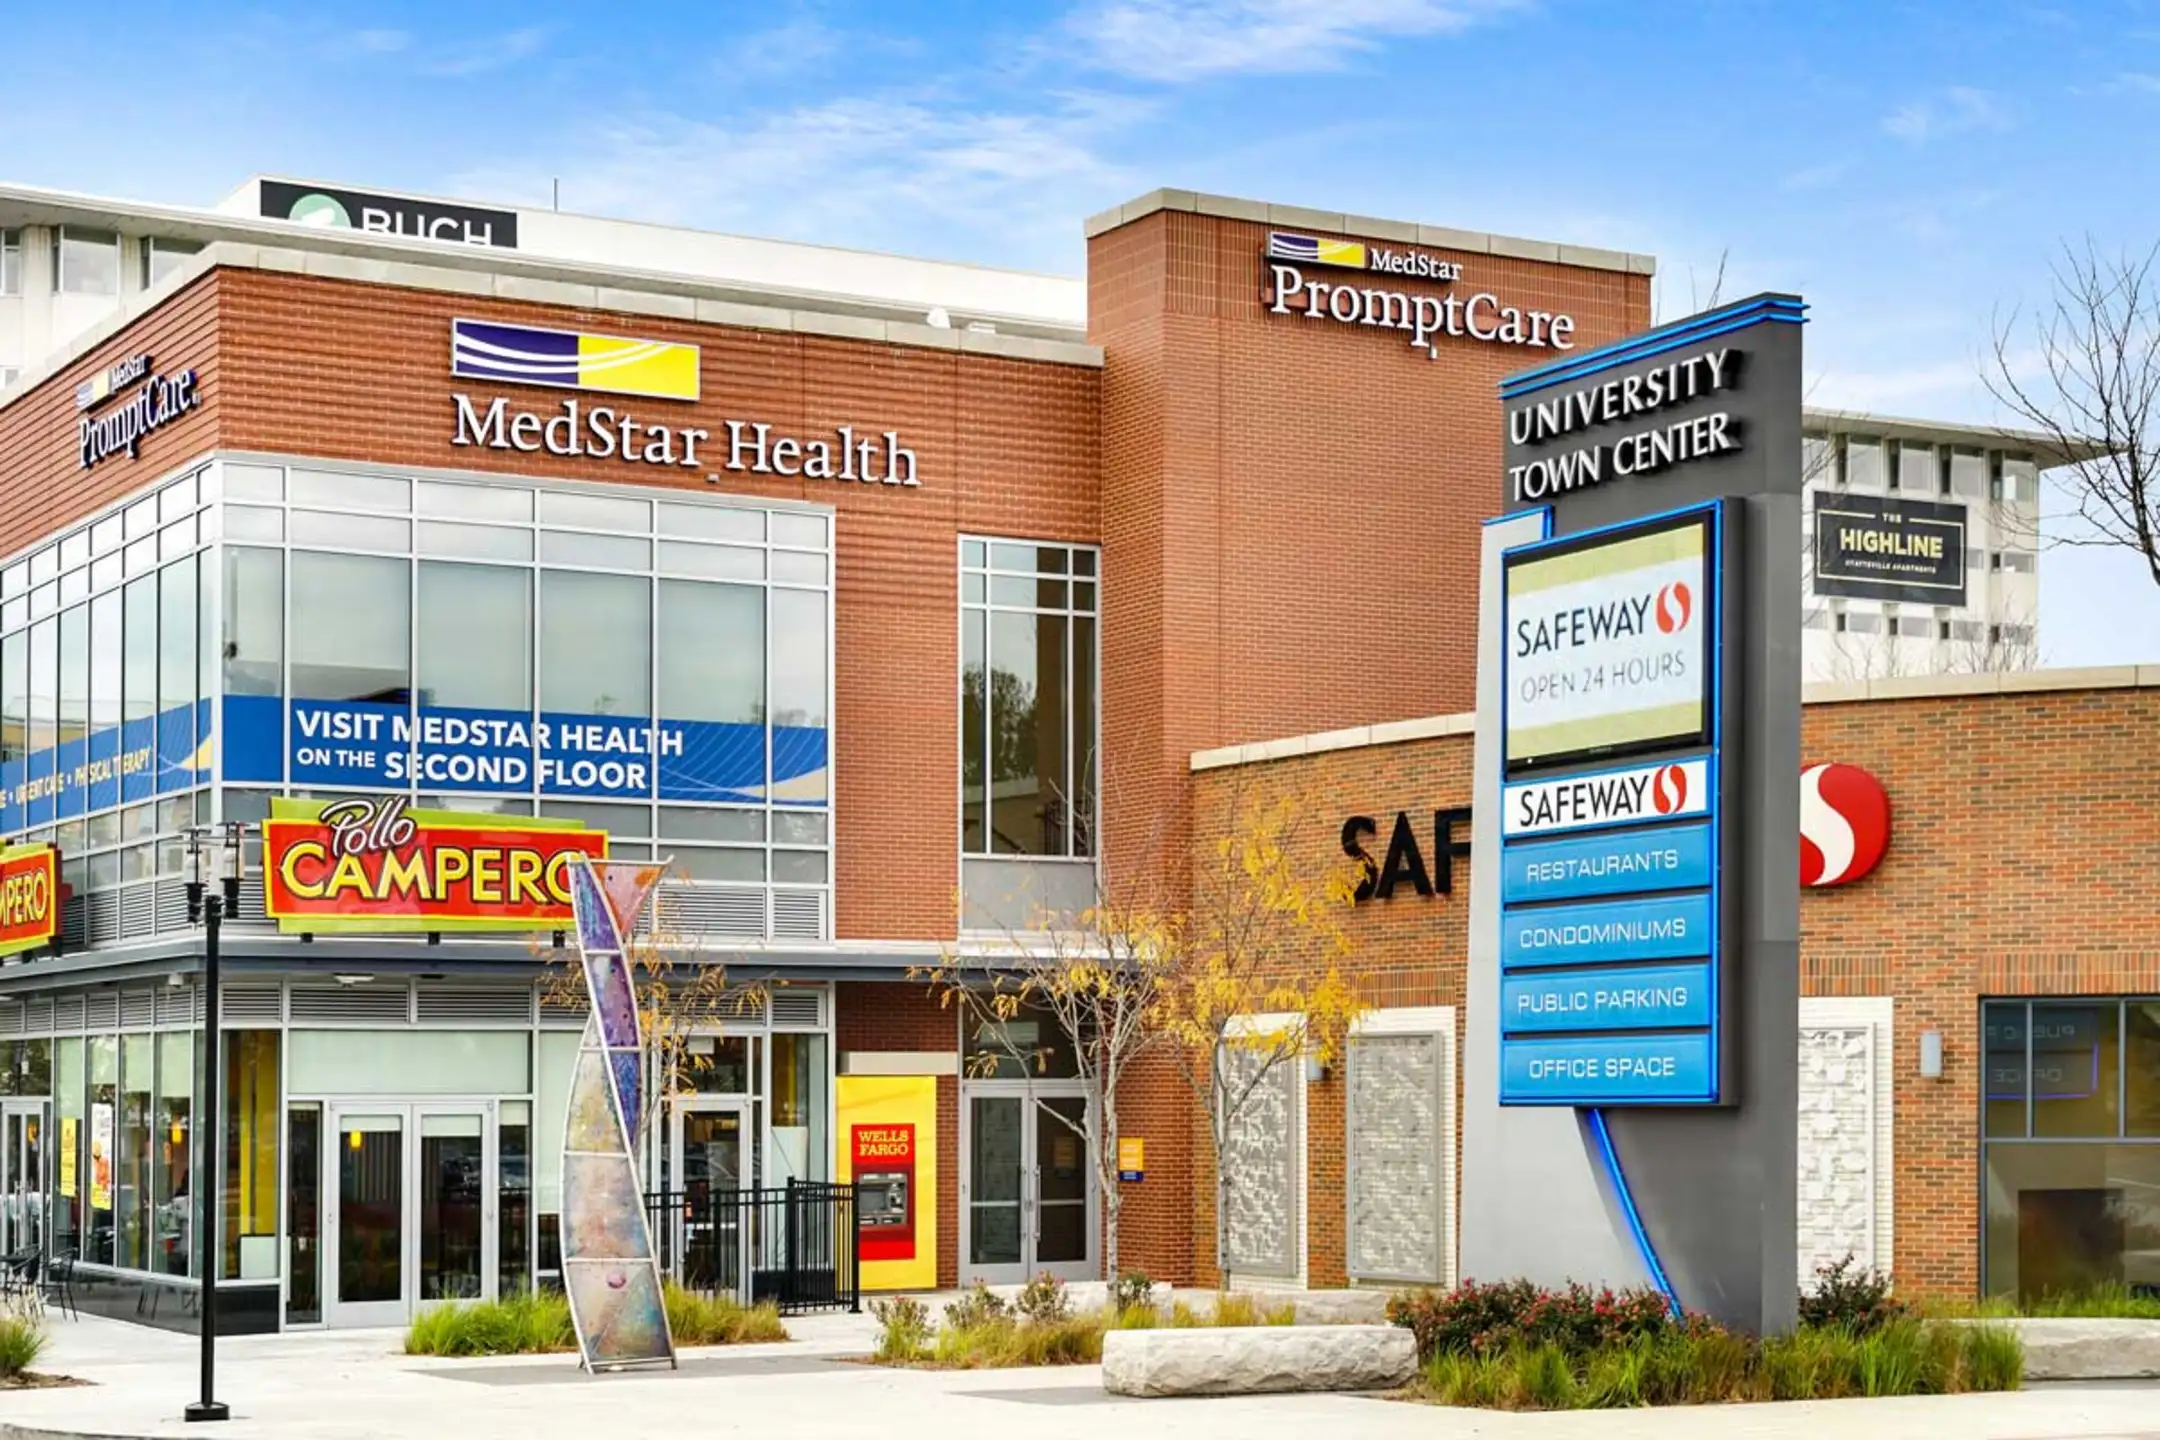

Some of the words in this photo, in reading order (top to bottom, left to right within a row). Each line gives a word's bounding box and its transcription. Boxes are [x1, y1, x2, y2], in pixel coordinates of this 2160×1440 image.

[1370, 247, 1463, 282] MedStar
[1270, 265, 1575, 349] PromptCare
[79, 369, 191, 467] PromptCare
[1510, 348, 1728, 445] UNIVERSITY
[452, 393, 709, 467] MedStar
[725, 419, 921, 486] Health
[1509, 445, 1600, 501] TOWN
[1613, 412, 1731, 475] CENTER
[1840, 528, 1944, 559] HIGHLINE
[1516, 594, 1651, 658] SAFEWAY
[1520, 672, 1576, 704] OPEN
[1582, 665, 1605, 693] 24
[1612, 650, 1686, 688] HOURS
[296, 710, 384, 742] VISIT
[392, 715, 553, 750] MEDSTAR
[560, 725, 684, 757] HEALTH
[296, 748, 330, 766] ON
[336, 750, 376, 769] THE
[384, 751, 527, 784] SECOND
[537, 759, 647, 790] FLOOR
[1519, 774, 1649, 828] SAFEWAY
[320, 797, 415, 857] Pollo
[1527, 849, 1679, 882] RESTAURANTS
[1519, 917, 1686, 948] CONDOMINIUMS
[1518, 991, 1588, 1013] PUBLIC
[1594, 987, 1688, 1010] PARKING
[1529, 1058, 1599, 1079] OFFICE
[1604, 1056, 1677, 1079] SPACE
[858, 1130, 909, 1143] WELLS
[859, 1143, 909, 1156] FARGO
